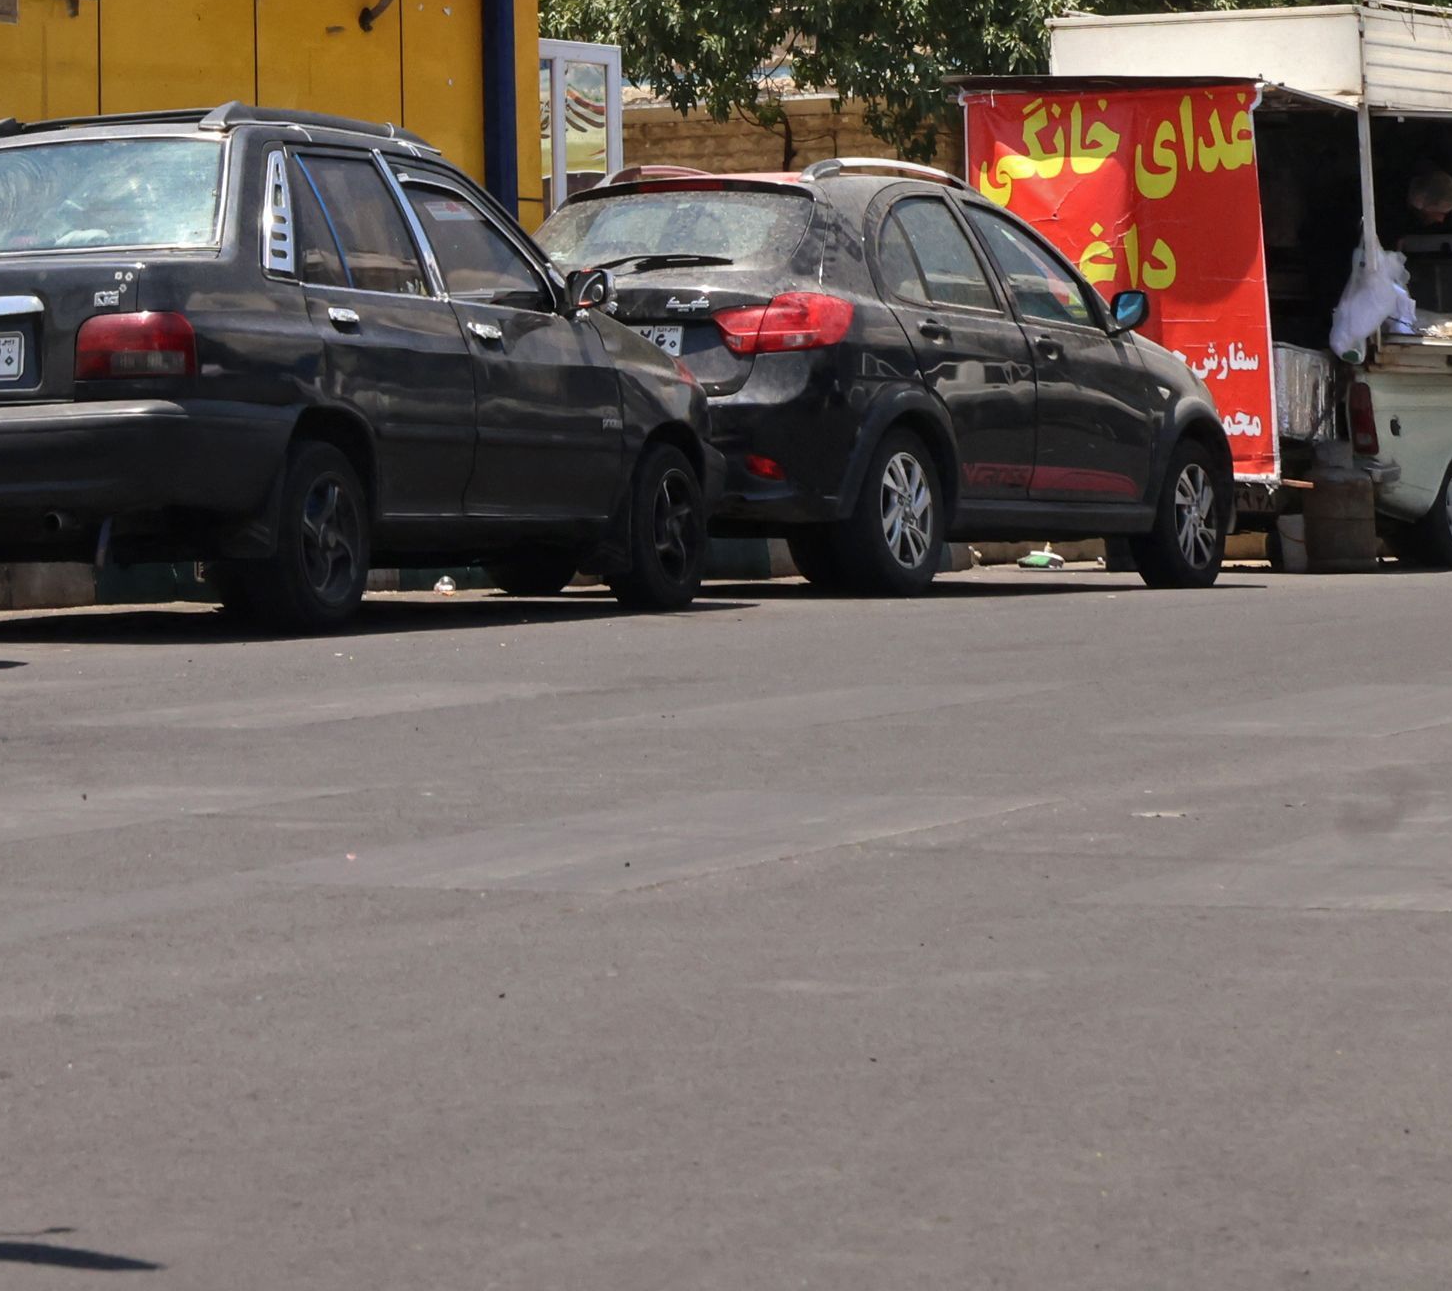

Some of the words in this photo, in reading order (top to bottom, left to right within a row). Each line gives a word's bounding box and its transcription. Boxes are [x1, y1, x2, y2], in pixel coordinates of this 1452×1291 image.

[979, 98, 1121, 209] خانگی
[1135, 92, 1256, 200] غذای
[1192, 342, 1259, 380] سفارش
